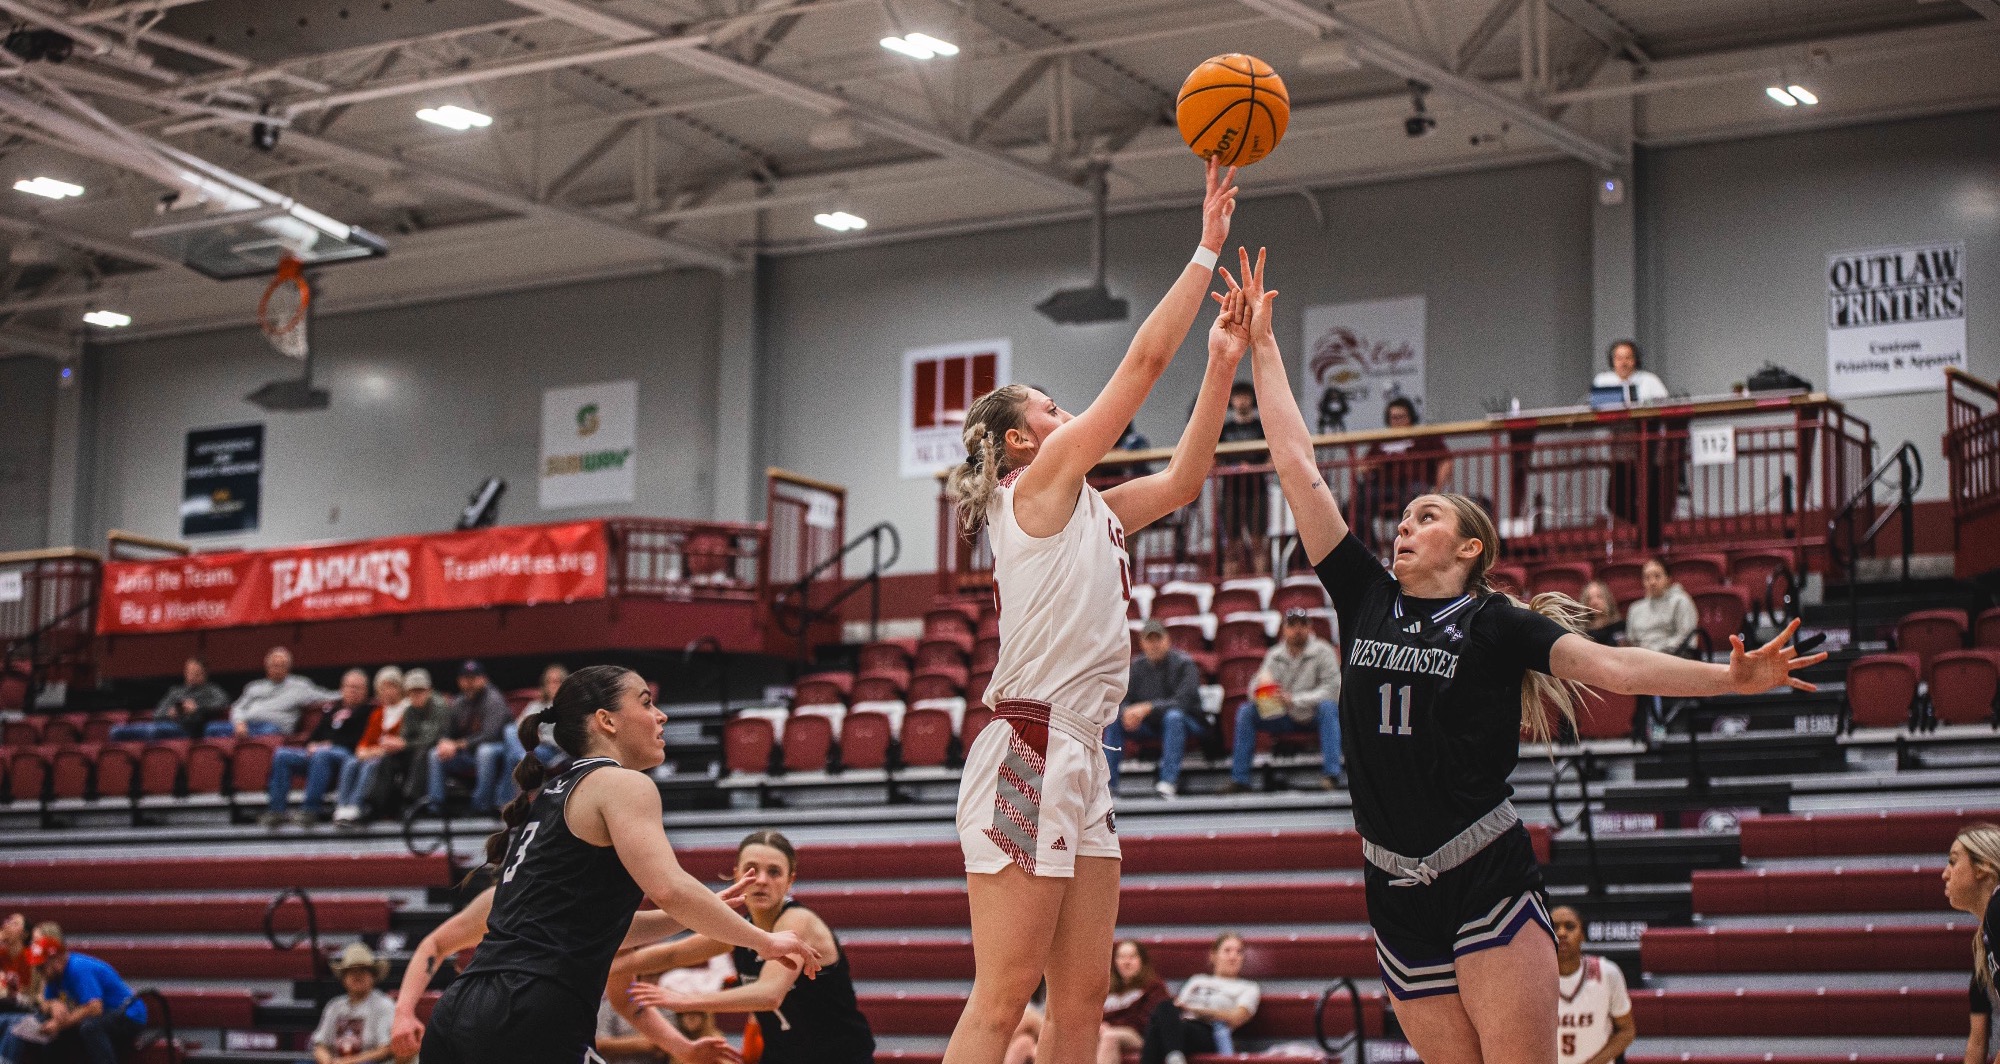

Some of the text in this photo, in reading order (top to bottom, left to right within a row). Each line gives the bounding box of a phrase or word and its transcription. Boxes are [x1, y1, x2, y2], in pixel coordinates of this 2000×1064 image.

[1830, 249, 1959, 292] OUTLAW
[1831, 281, 1963, 328] PRINTERS
[1702, 434, 1728, 454] 112
[120, 602, 145, 624] Be
[150, 607, 161, 622] a
[1350, 638, 1459, 679] WESTMINSTER
[1379, 683, 1412, 735] 11
